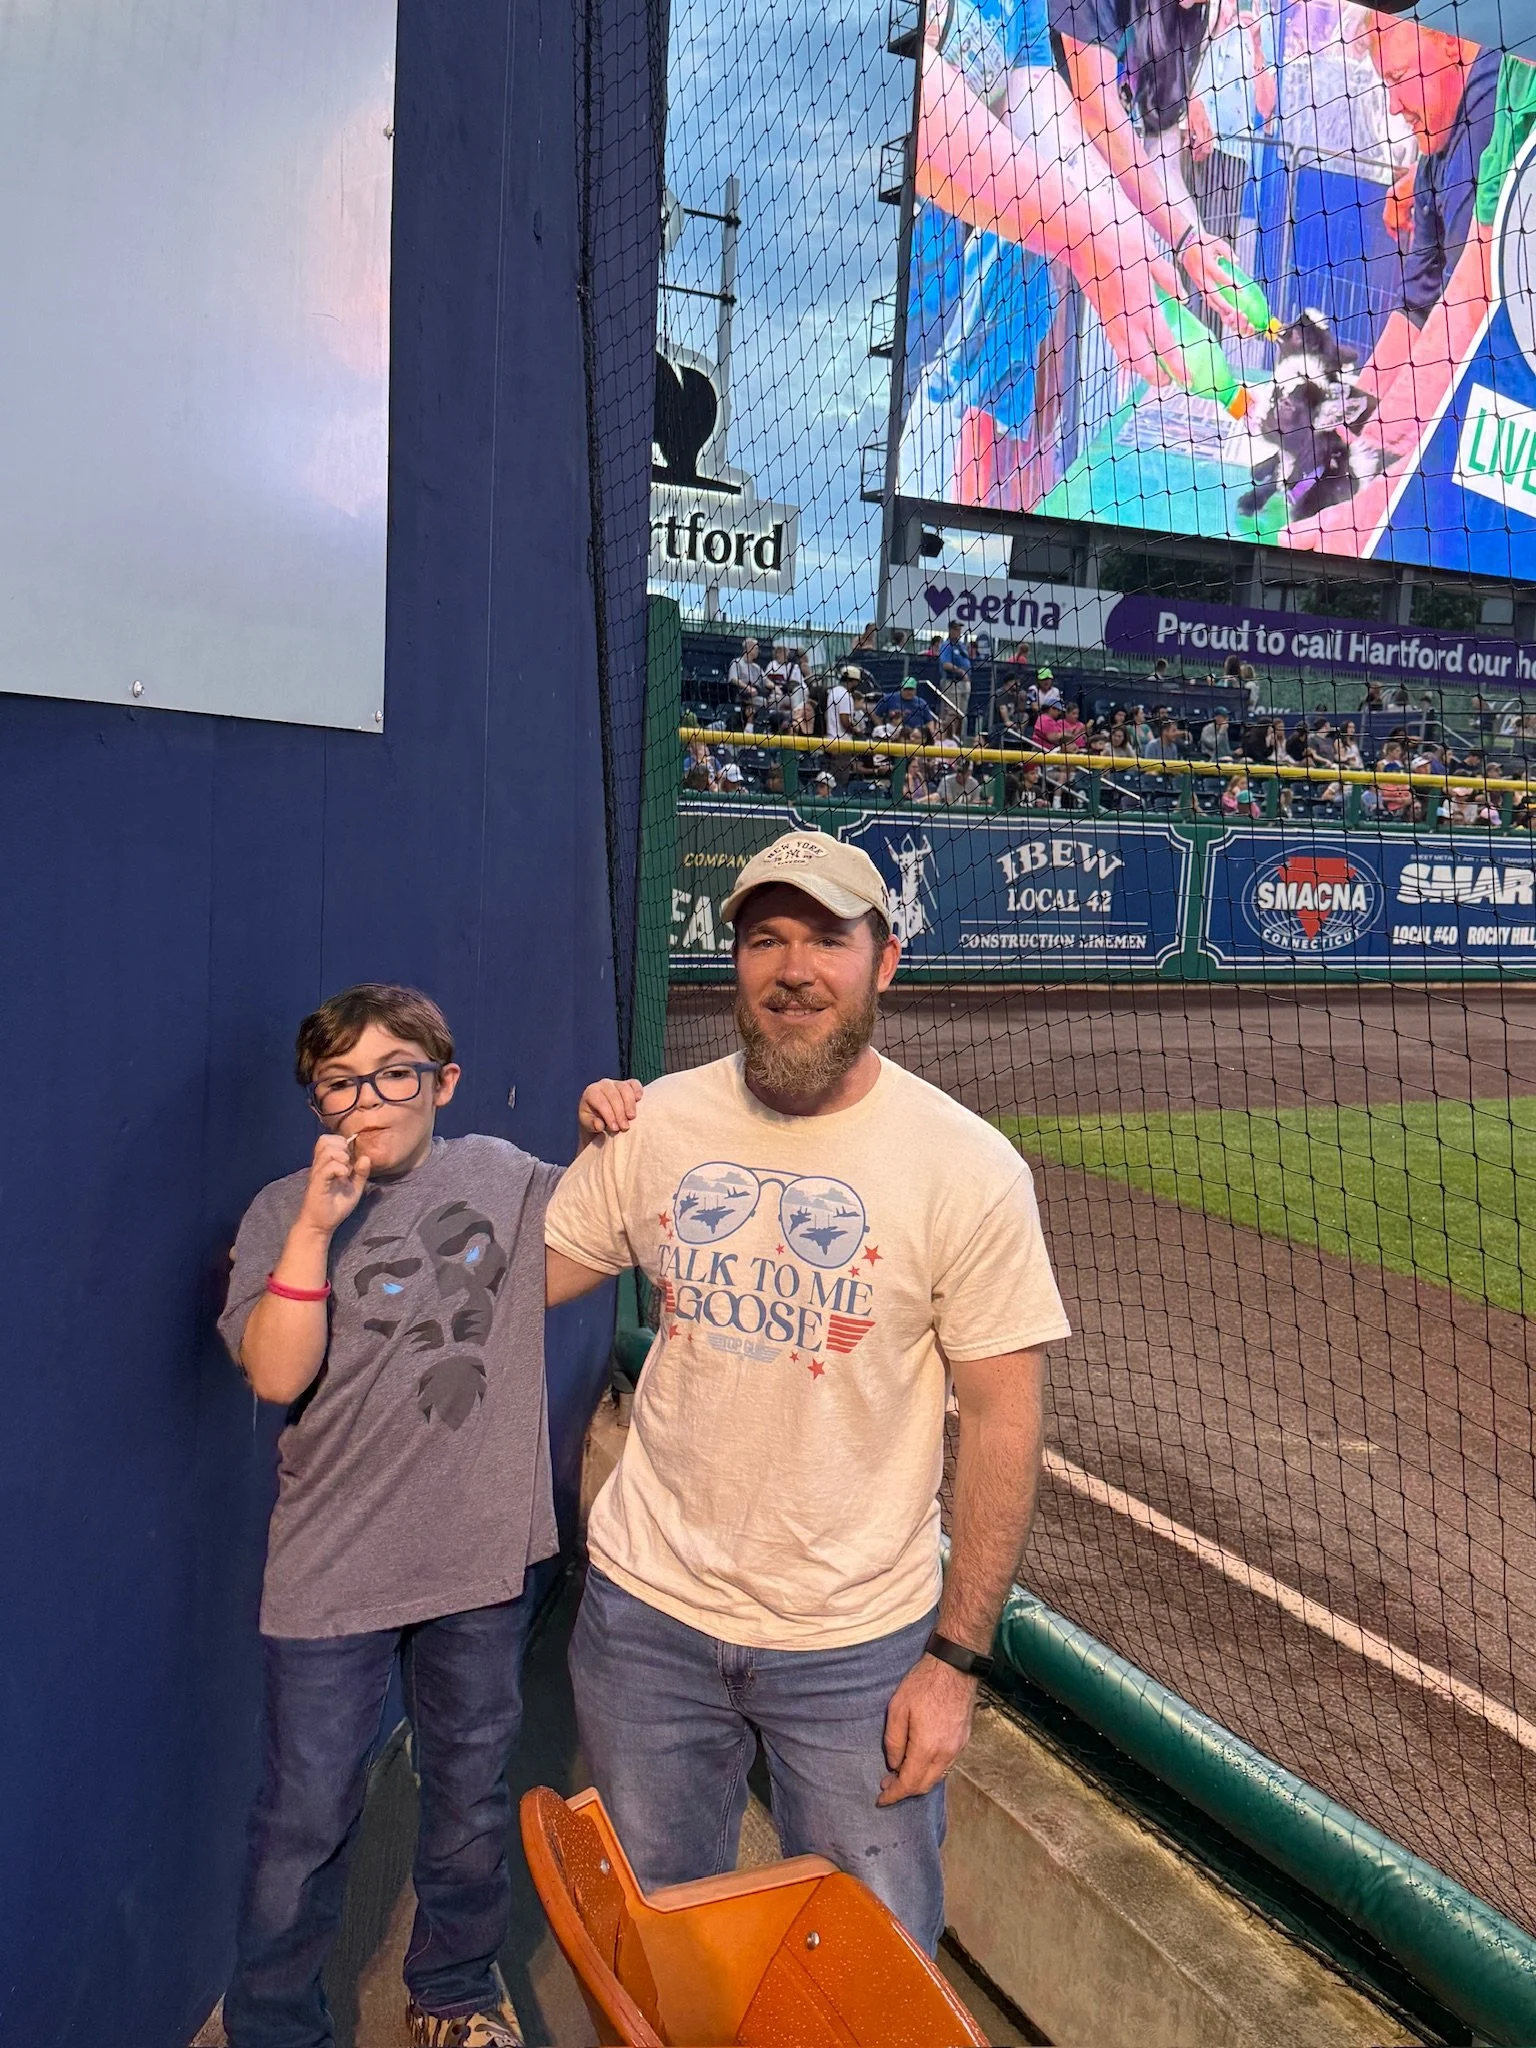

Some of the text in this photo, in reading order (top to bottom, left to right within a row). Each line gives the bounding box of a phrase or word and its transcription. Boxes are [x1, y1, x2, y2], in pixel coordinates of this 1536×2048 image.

[957, 589, 1061, 630] aetna
[1157, 612, 1249, 652] Proud
[1256, 625, 1286, 656] to
[1291, 629, 1342, 660] call
[1349, 633, 1463, 674] Hartford
[1468, 650, 1512, 678] our
[997, 839, 1125, 884] IBEW
[1007, 888, 1112, 913] LOCAL 42
[1256, 881, 1368, 912] SMACNA
[959, 933, 1147, 950] CONSTRUCTION LINEMEN
[1262, 928, 1360, 950] CONNECTICUT
[1393, 925, 1432, 945] LOCAL
[1433, 925, 1458, 945] #40
[657, 1243, 873, 1317] TALK TO ME
[675, 1285, 823, 1352] GOOSE
